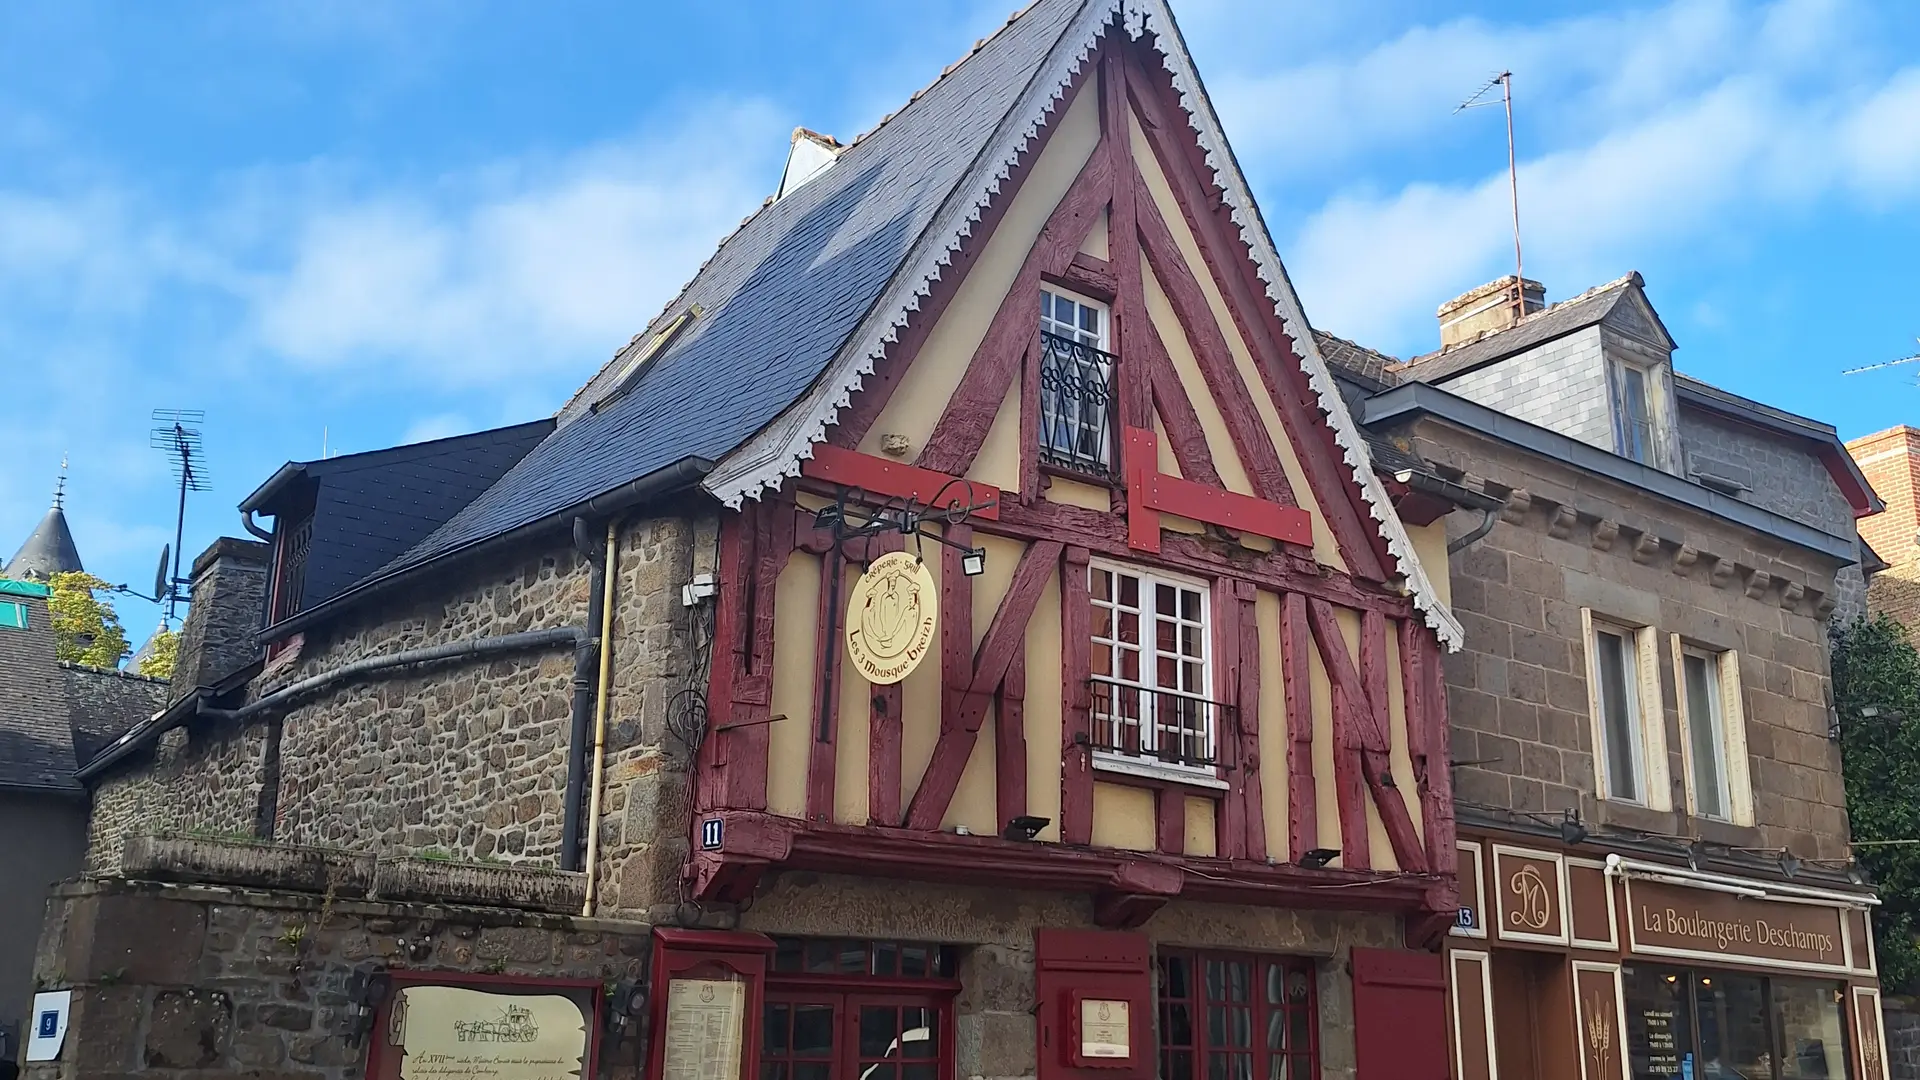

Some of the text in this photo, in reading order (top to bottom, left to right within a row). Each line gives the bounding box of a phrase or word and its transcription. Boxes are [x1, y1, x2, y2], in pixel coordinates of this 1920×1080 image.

[849, 628, 860, 656] Les
[858, 653, 865, 664] 3
[863, 660, 909, 679] Mousque
[705, 822, 719, 845] 11
[1458, 908, 1472, 926] 13
[1642, 905, 1833, 961] La Boulangerie Deschamps
[45, 1017, 52, 1031] 9
